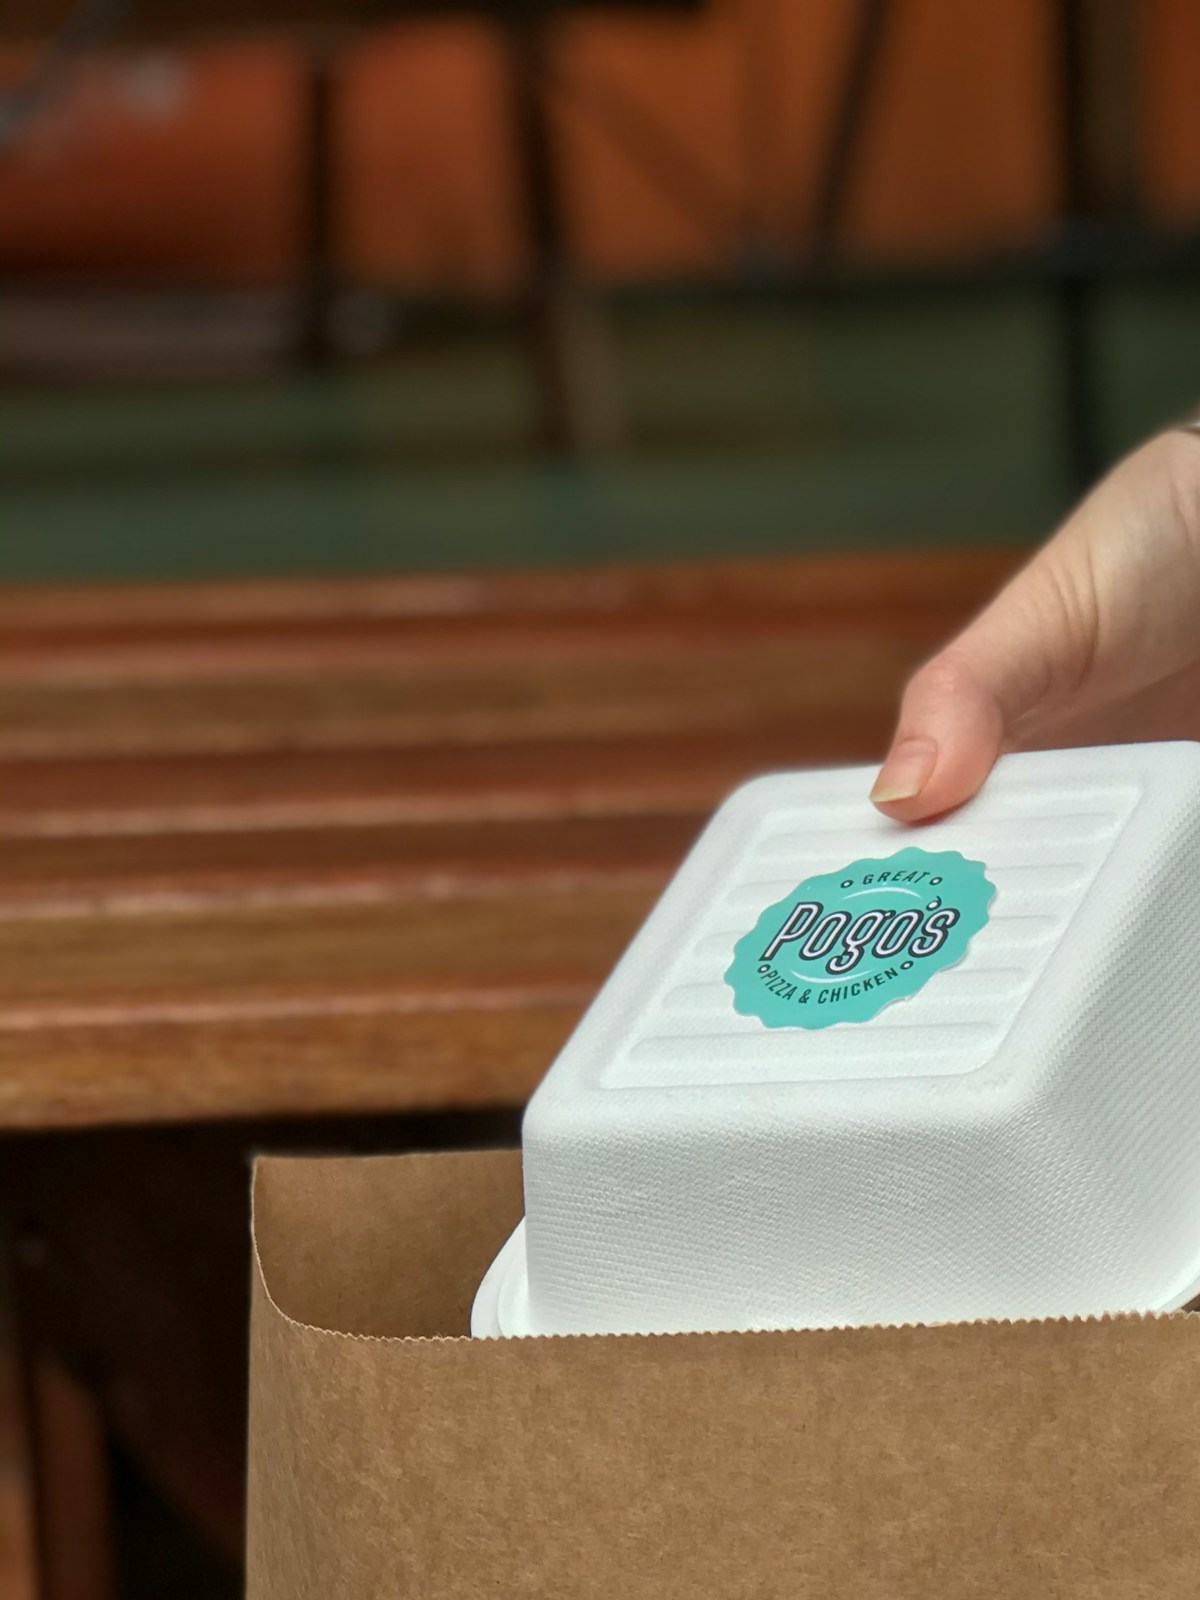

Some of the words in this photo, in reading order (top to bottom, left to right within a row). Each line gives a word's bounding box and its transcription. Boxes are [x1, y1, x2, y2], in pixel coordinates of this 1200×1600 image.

[863, 870, 930, 885] GREAT
[759, 896, 960, 975] Pogo's
[760, 971, 797, 1001] PIZZA
[798, 988, 810, 1004] &
[817, 967, 899, 1004] CHICKEN
